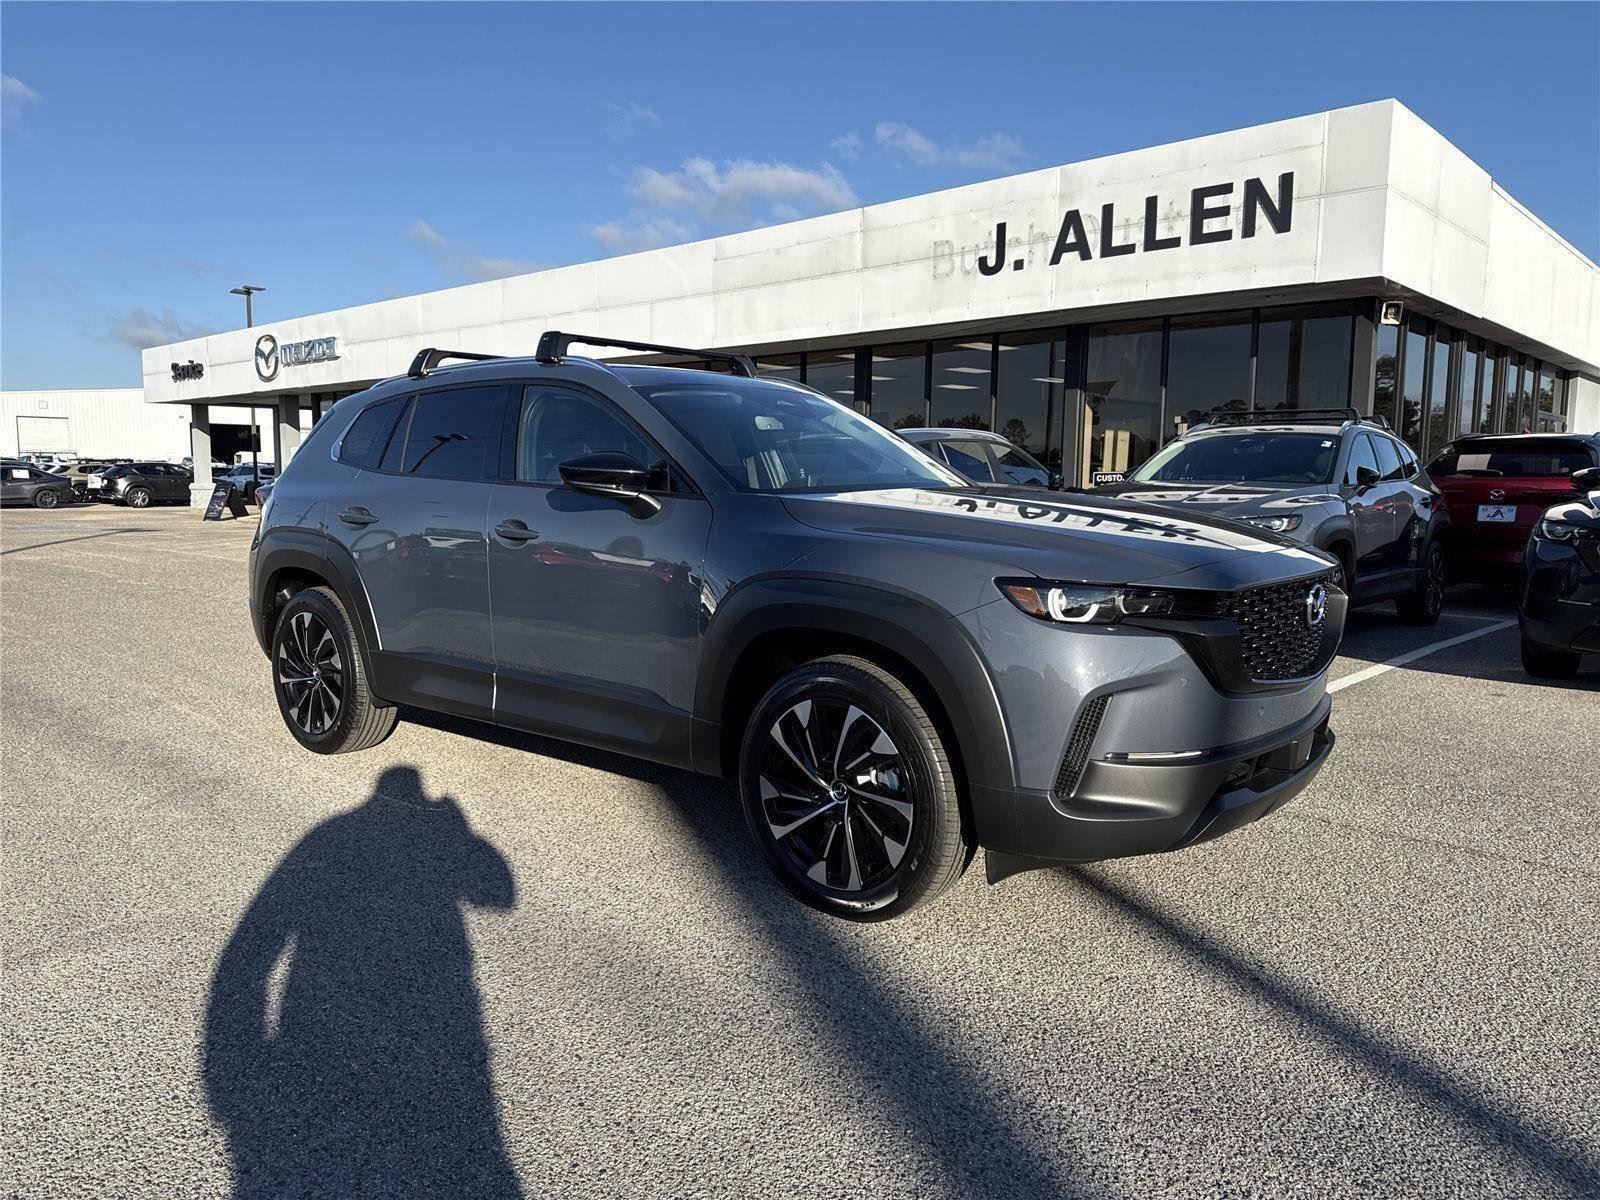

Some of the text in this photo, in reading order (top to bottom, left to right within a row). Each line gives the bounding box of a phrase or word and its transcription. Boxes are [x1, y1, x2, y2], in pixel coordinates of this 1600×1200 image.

[978, 222, 1024, 276] J.
[1049, 171, 1294, 266] ALLEN
[1096, 474, 1125, 482] CUSTO
